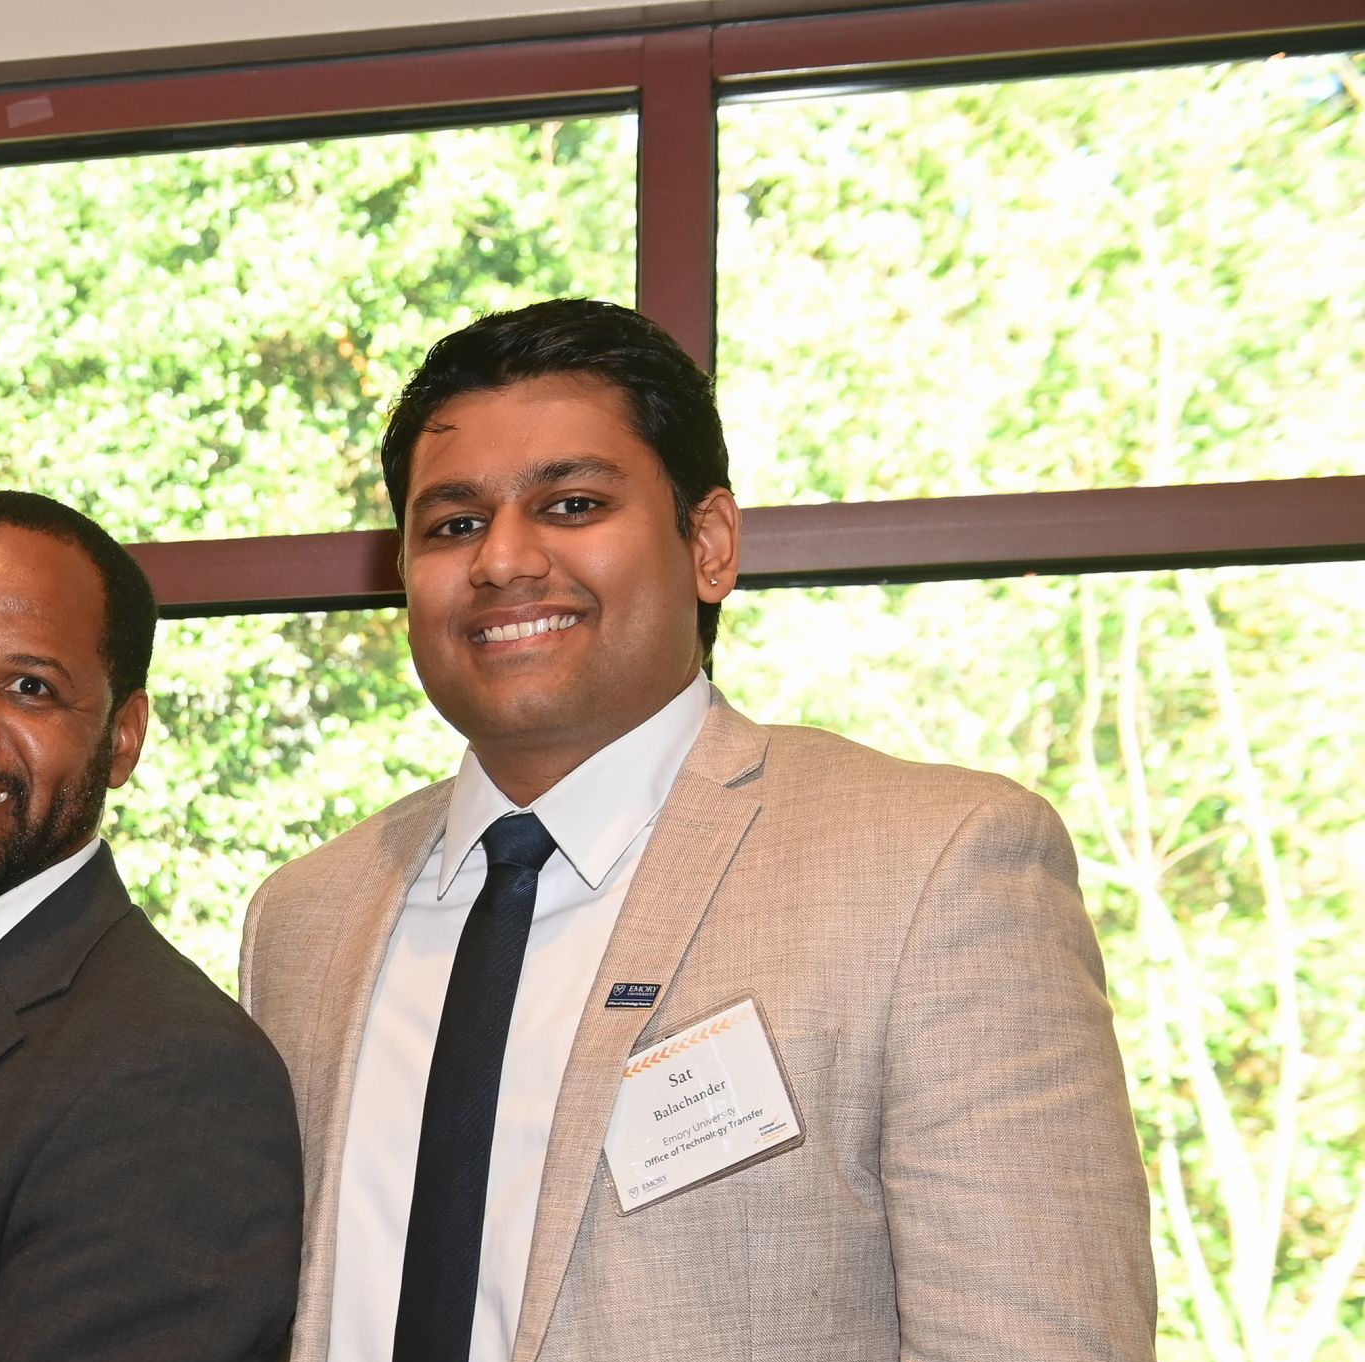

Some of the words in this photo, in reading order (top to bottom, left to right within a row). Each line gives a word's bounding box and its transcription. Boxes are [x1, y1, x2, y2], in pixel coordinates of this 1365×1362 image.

[628, 985, 657, 993] EMORY
[668, 1068, 694, 1088] Sat
[653, 1081, 726, 1122] Balachander
[644, 1152, 669, 1168] Office
[670, 1146, 680, 1157] of
[680, 1126, 727, 1152] Technology
[728, 1108, 764, 1129] Transfer
[662, 1128, 692, 1146] Emory
[692, 1106, 736, 1132] University
